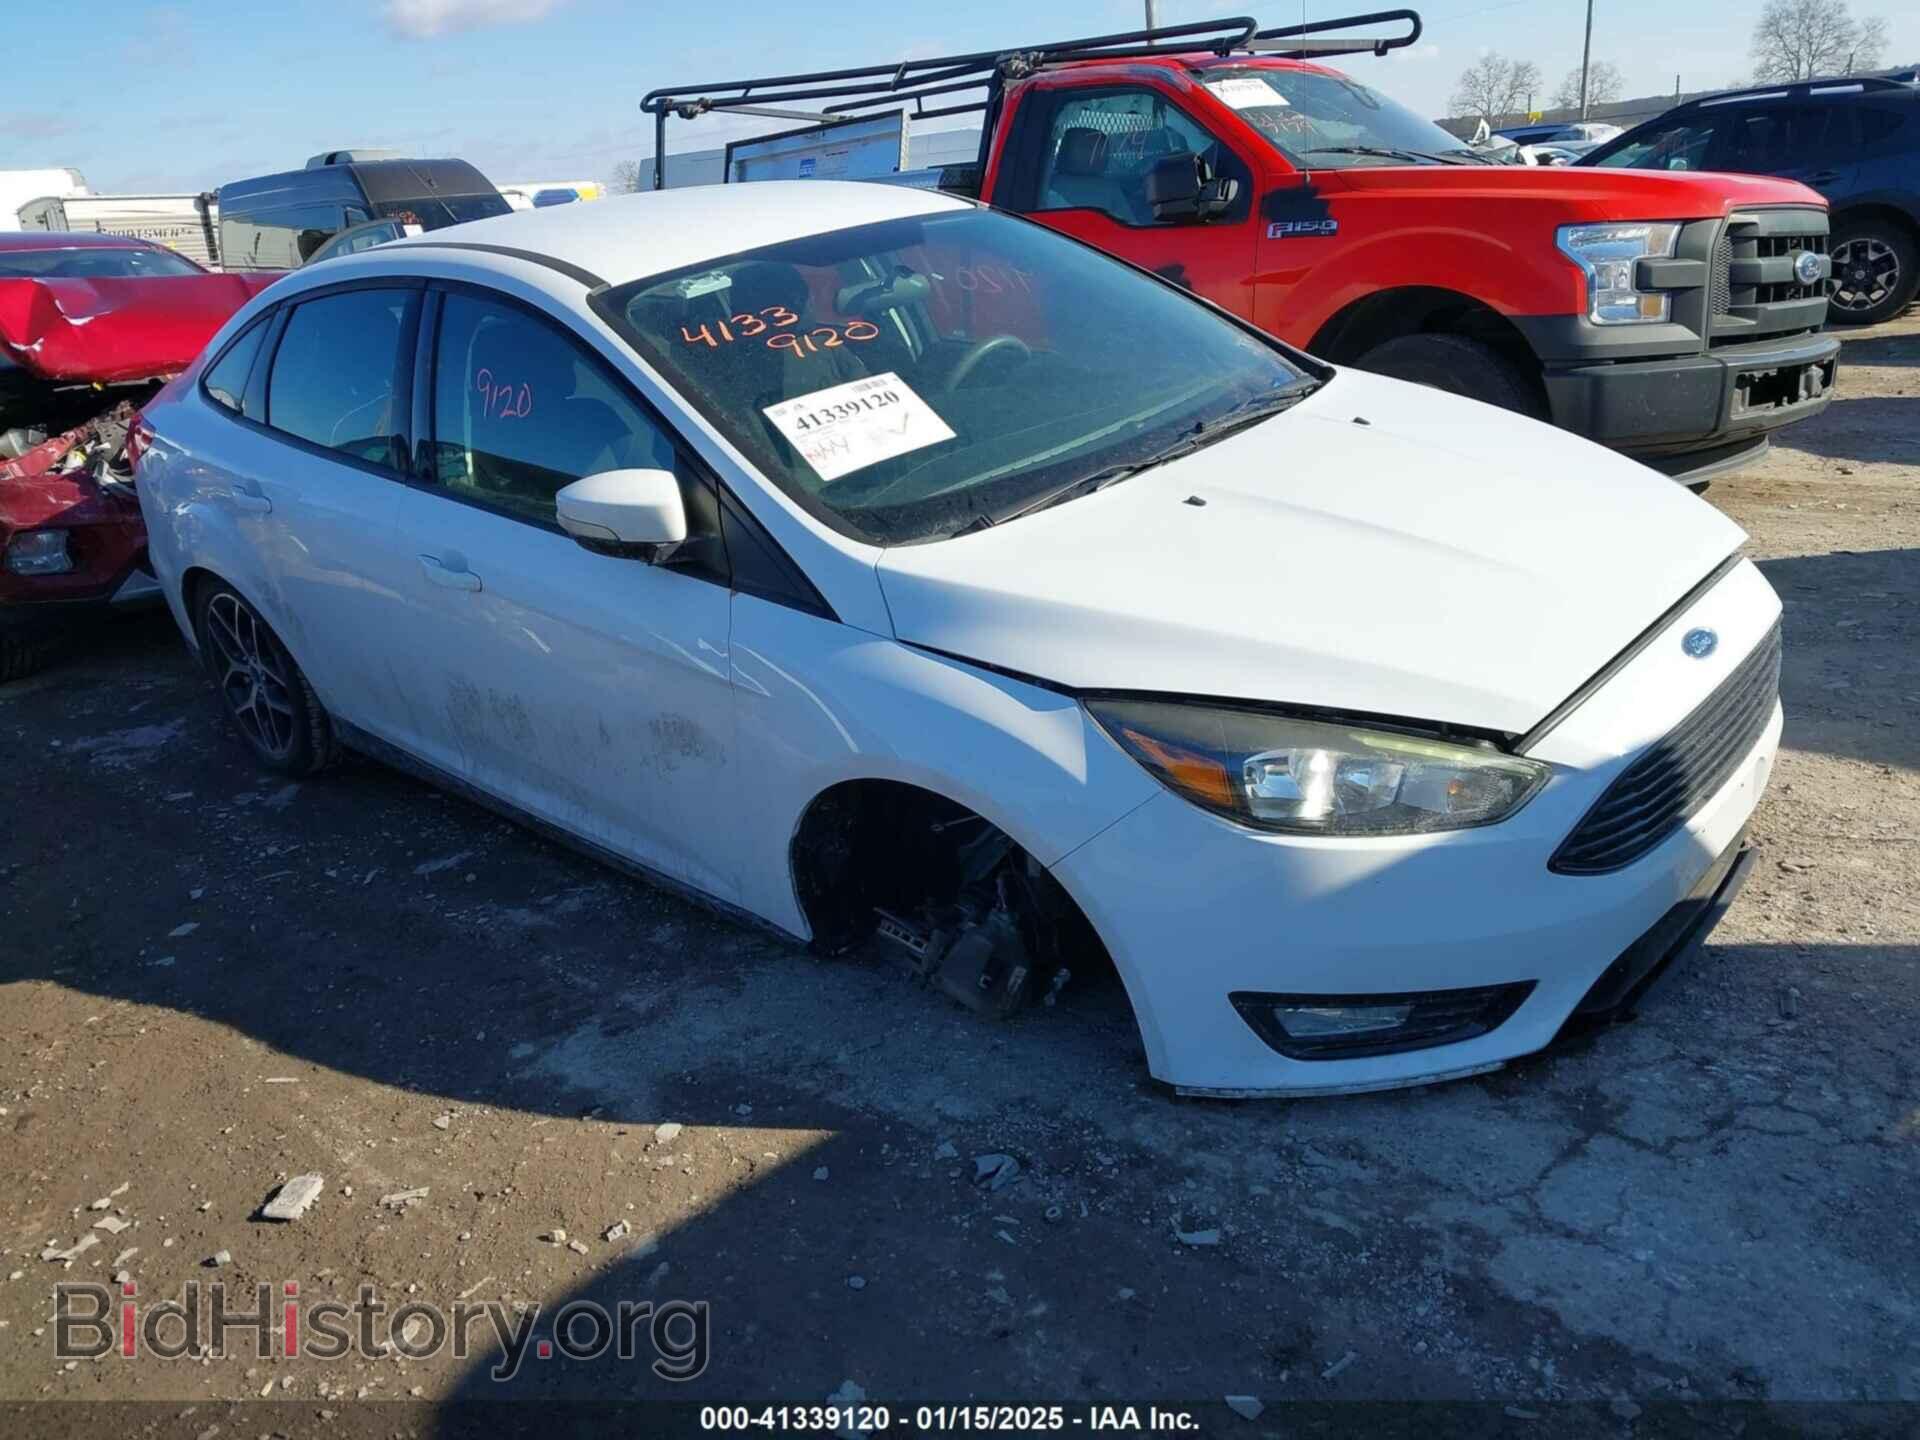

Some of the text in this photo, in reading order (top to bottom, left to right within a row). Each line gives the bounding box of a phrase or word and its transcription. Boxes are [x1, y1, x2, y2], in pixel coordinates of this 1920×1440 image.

[681, 306, 799, 347] 4133
[766, 321, 879, 358] 9120
[477, 368, 532, 419] 9120
[796, 390, 900, 431] 41339120
